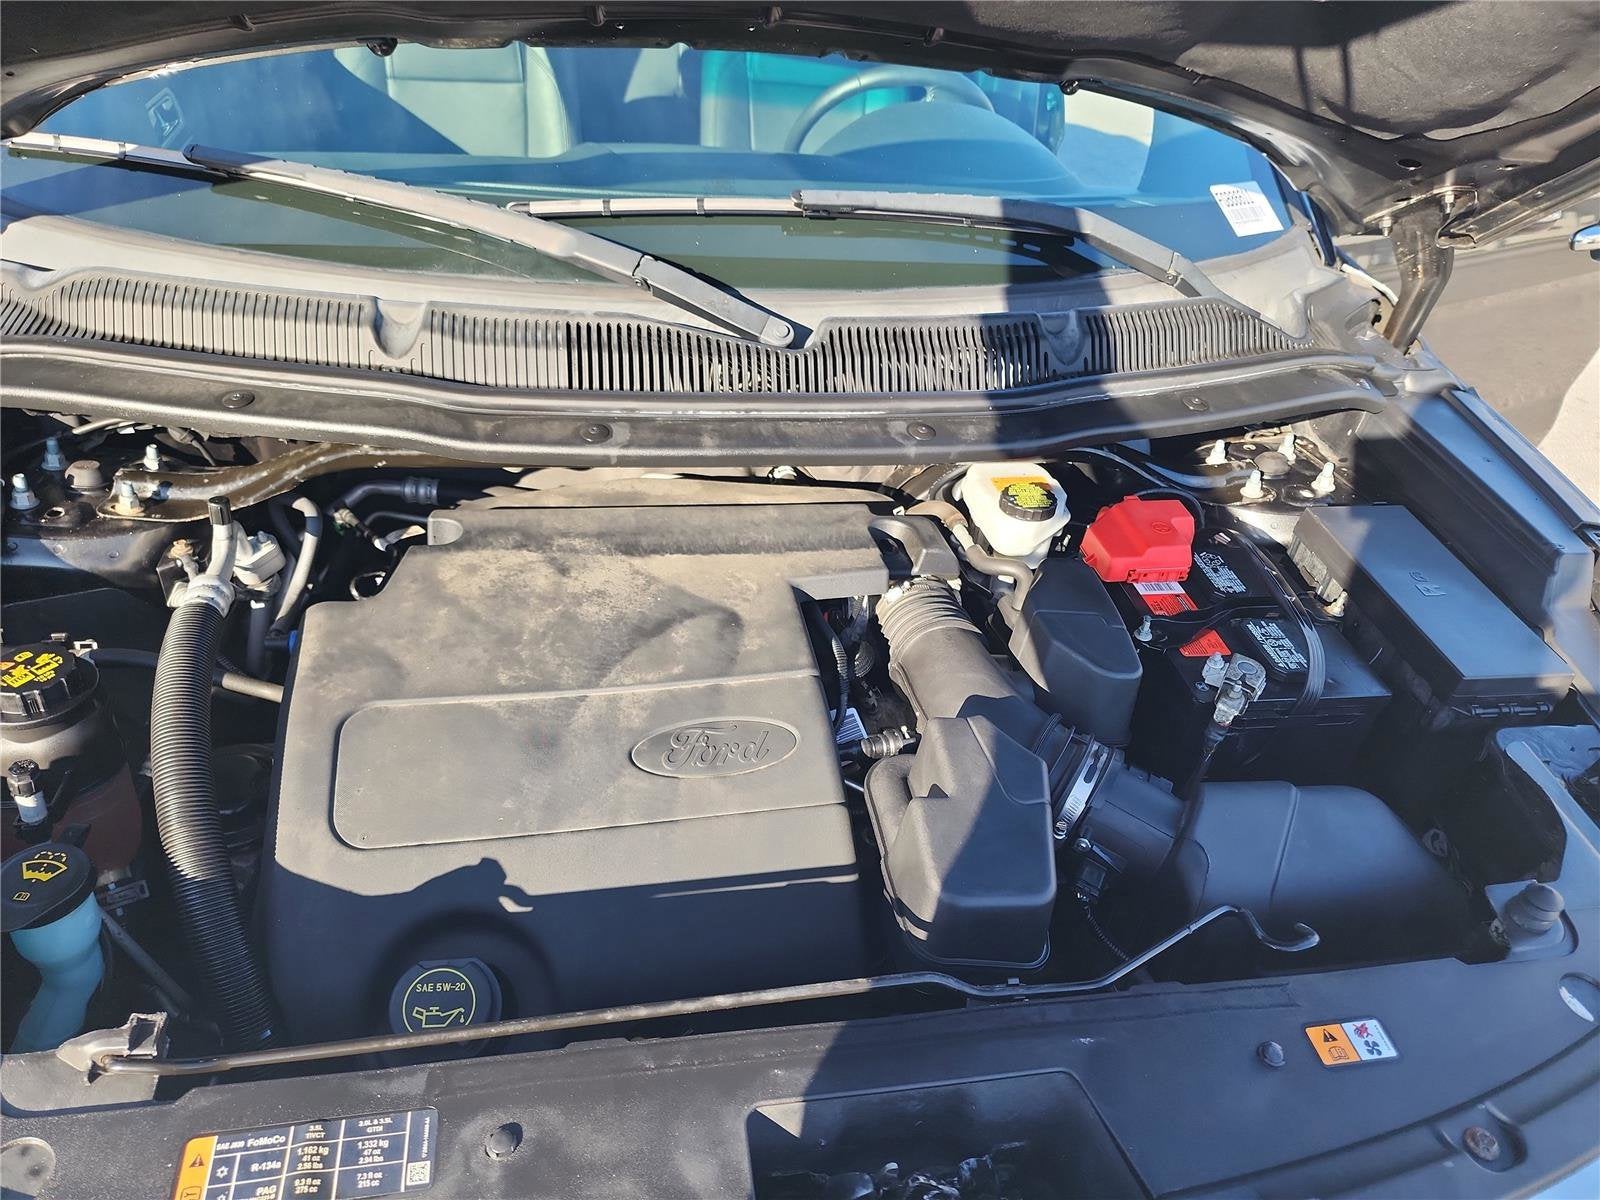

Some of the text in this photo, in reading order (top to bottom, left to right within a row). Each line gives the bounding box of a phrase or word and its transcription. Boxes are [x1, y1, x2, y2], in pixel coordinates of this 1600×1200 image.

[661, 726, 770, 770] Ford
[416, 982, 466, 992] SAE 5W-20
[246, 1134, 286, 1148] FoMoCo
[357, 1139, 389, 1149] 1.332 kg
[297, 1145, 330, 1156] 1.162 kg
[250, 1160, 282, 1172] R-134a
[357, 1180, 371, 1188] 215
[256, 1185, 277, 1196] PAG
